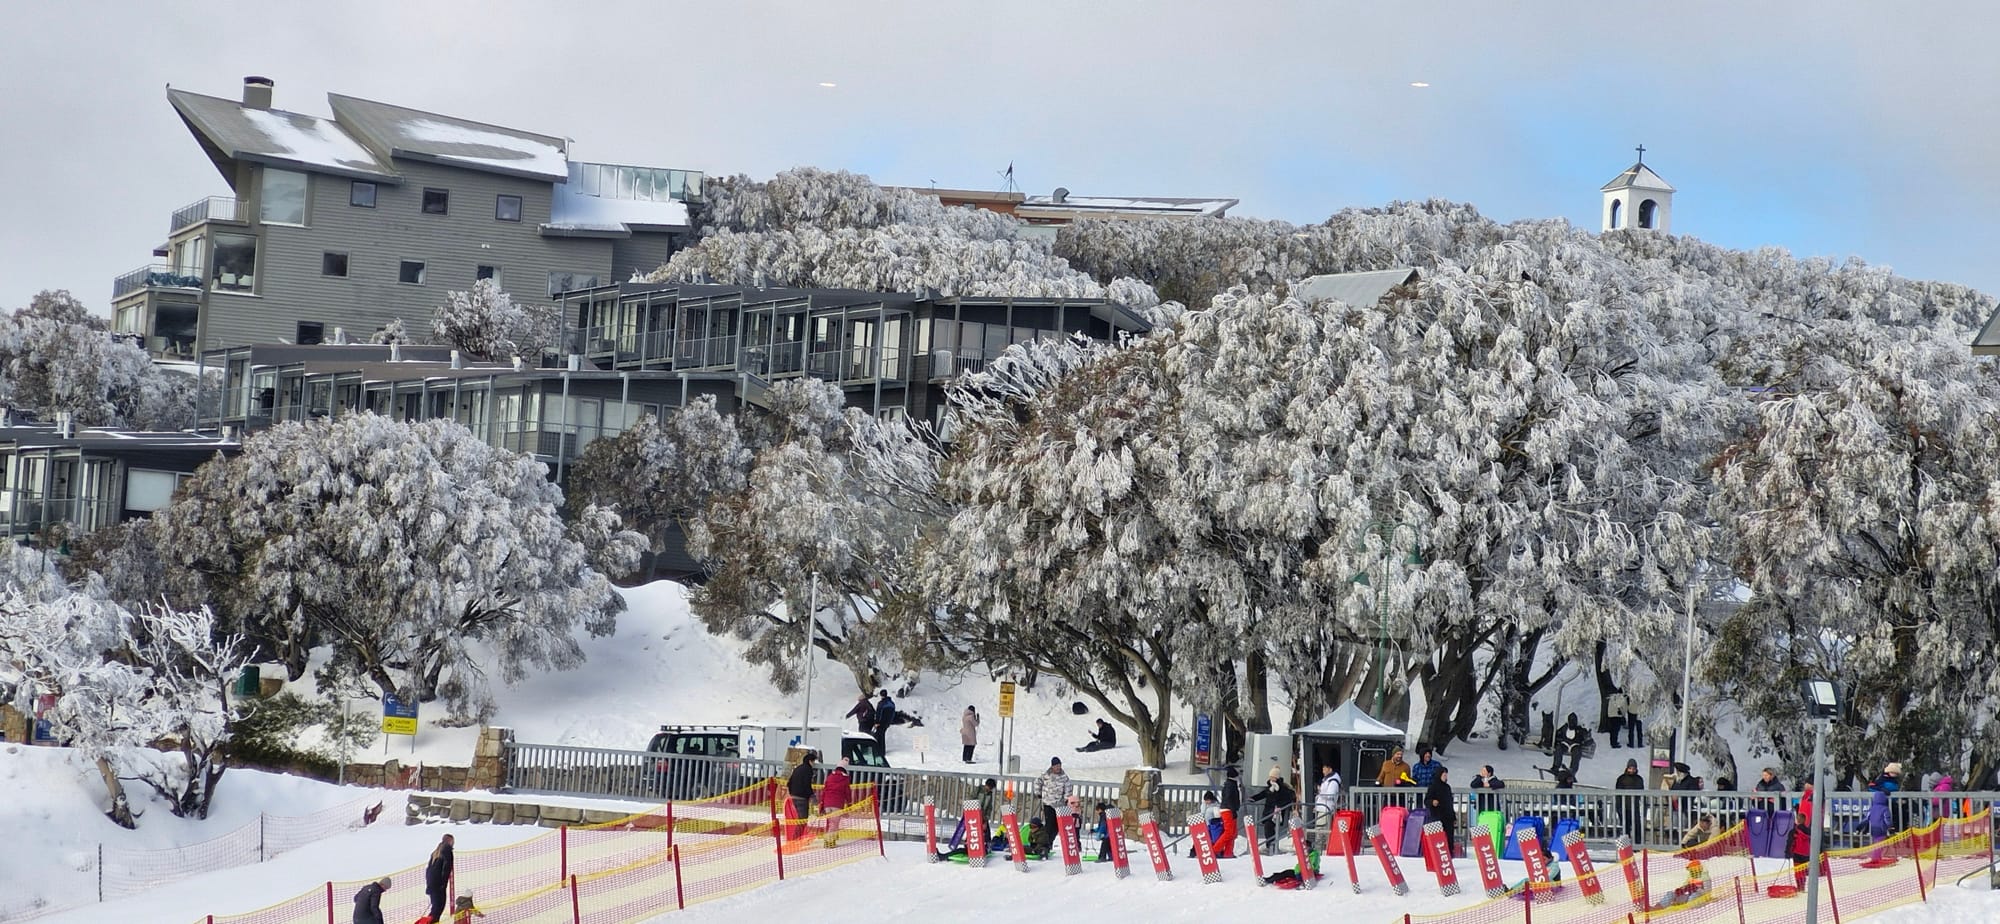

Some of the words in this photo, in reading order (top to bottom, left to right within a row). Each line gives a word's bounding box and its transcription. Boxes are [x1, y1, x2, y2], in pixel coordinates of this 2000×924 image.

[968, 818, 980, 850] Start
[1006, 824, 1018, 854] Start
[1064, 824, 1077, 856] Start
[1116, 827, 1126, 859] Start
[1147, 832, 1162, 864] Start
[1197, 832, 1213, 865] Start
[1382, 843, 1400, 876] Start
[1436, 841, 1452, 876] Start
[1481, 844, 1498, 880] Start
[1528, 849, 1546, 883] Start
